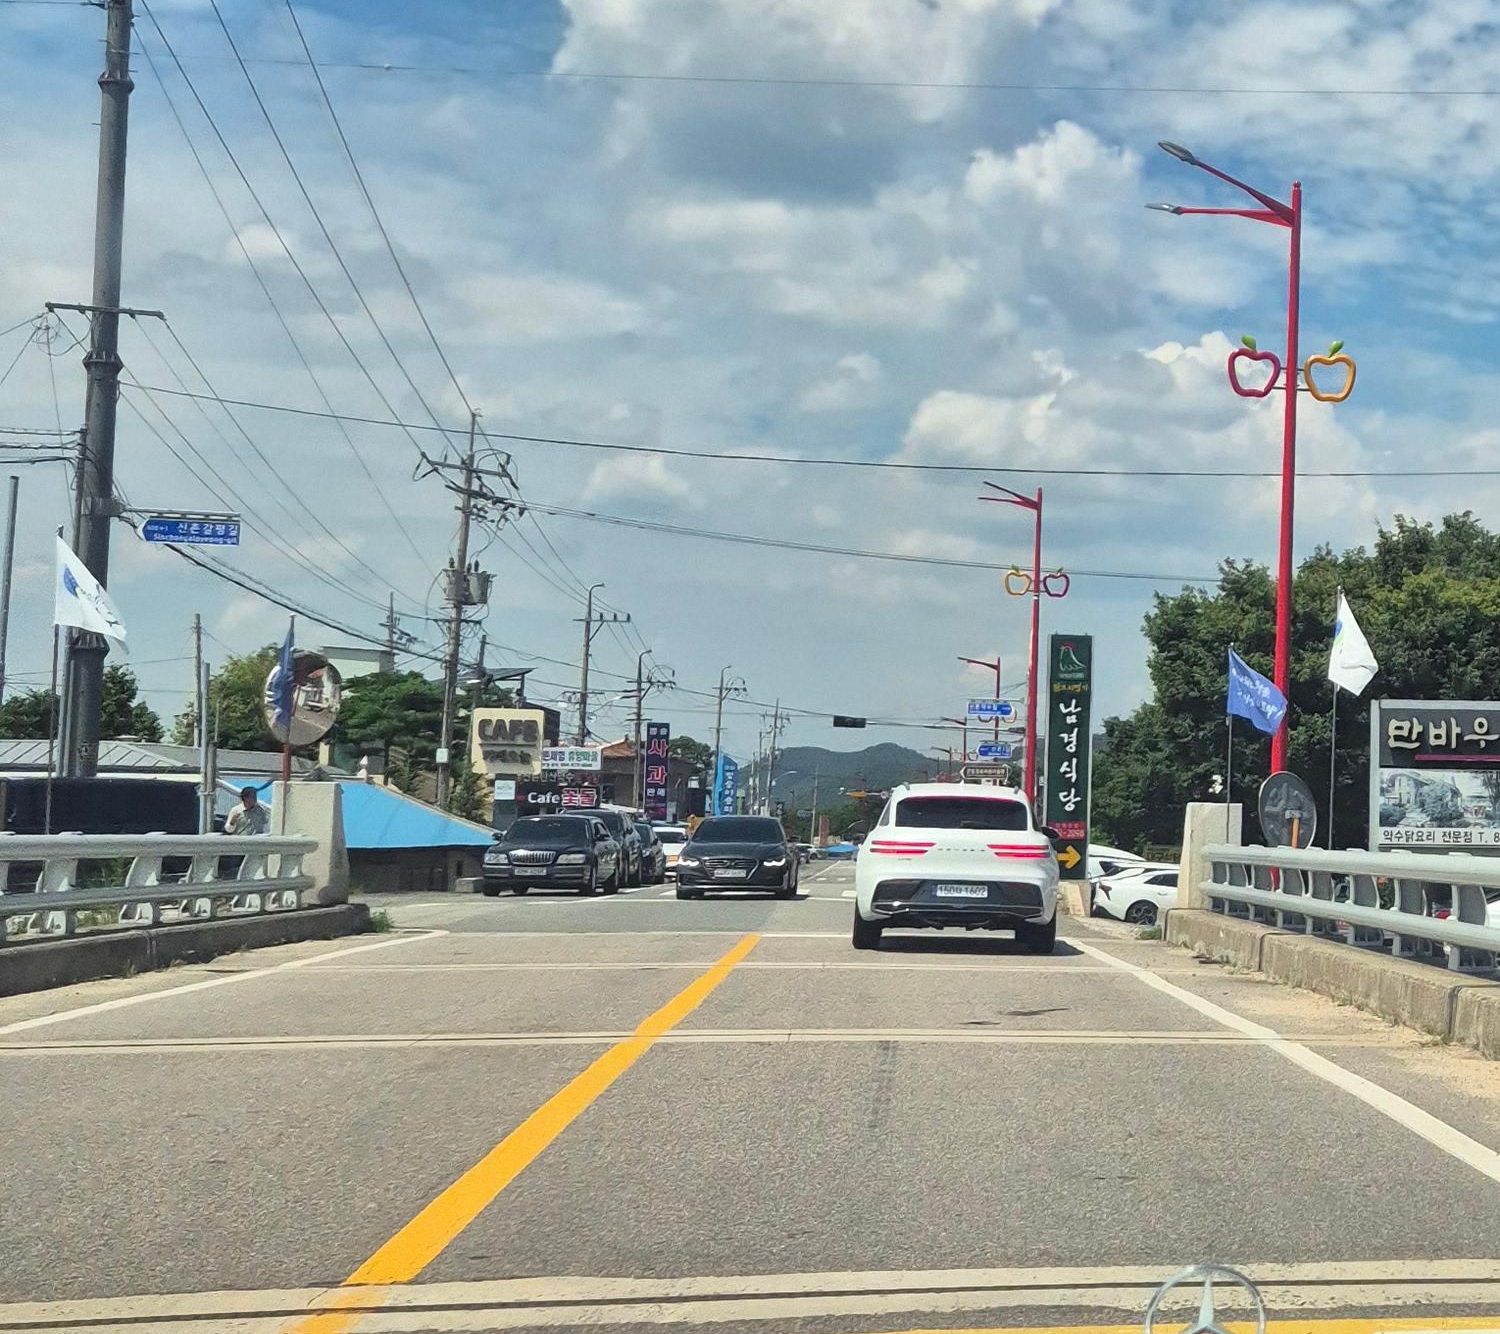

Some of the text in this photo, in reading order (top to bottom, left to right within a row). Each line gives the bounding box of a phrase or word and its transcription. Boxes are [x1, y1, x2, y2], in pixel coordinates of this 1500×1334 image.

[177, 522, 238, 536] 신촌갈평길
[478, 718, 539, 742] CAFE
[647, 738, 668, 786] 사과
[1059, 698, 1082, 812] 남경식당
[527, 791, 560, 804] Cafe
[1441, 831, 1473, 844] 전문점
